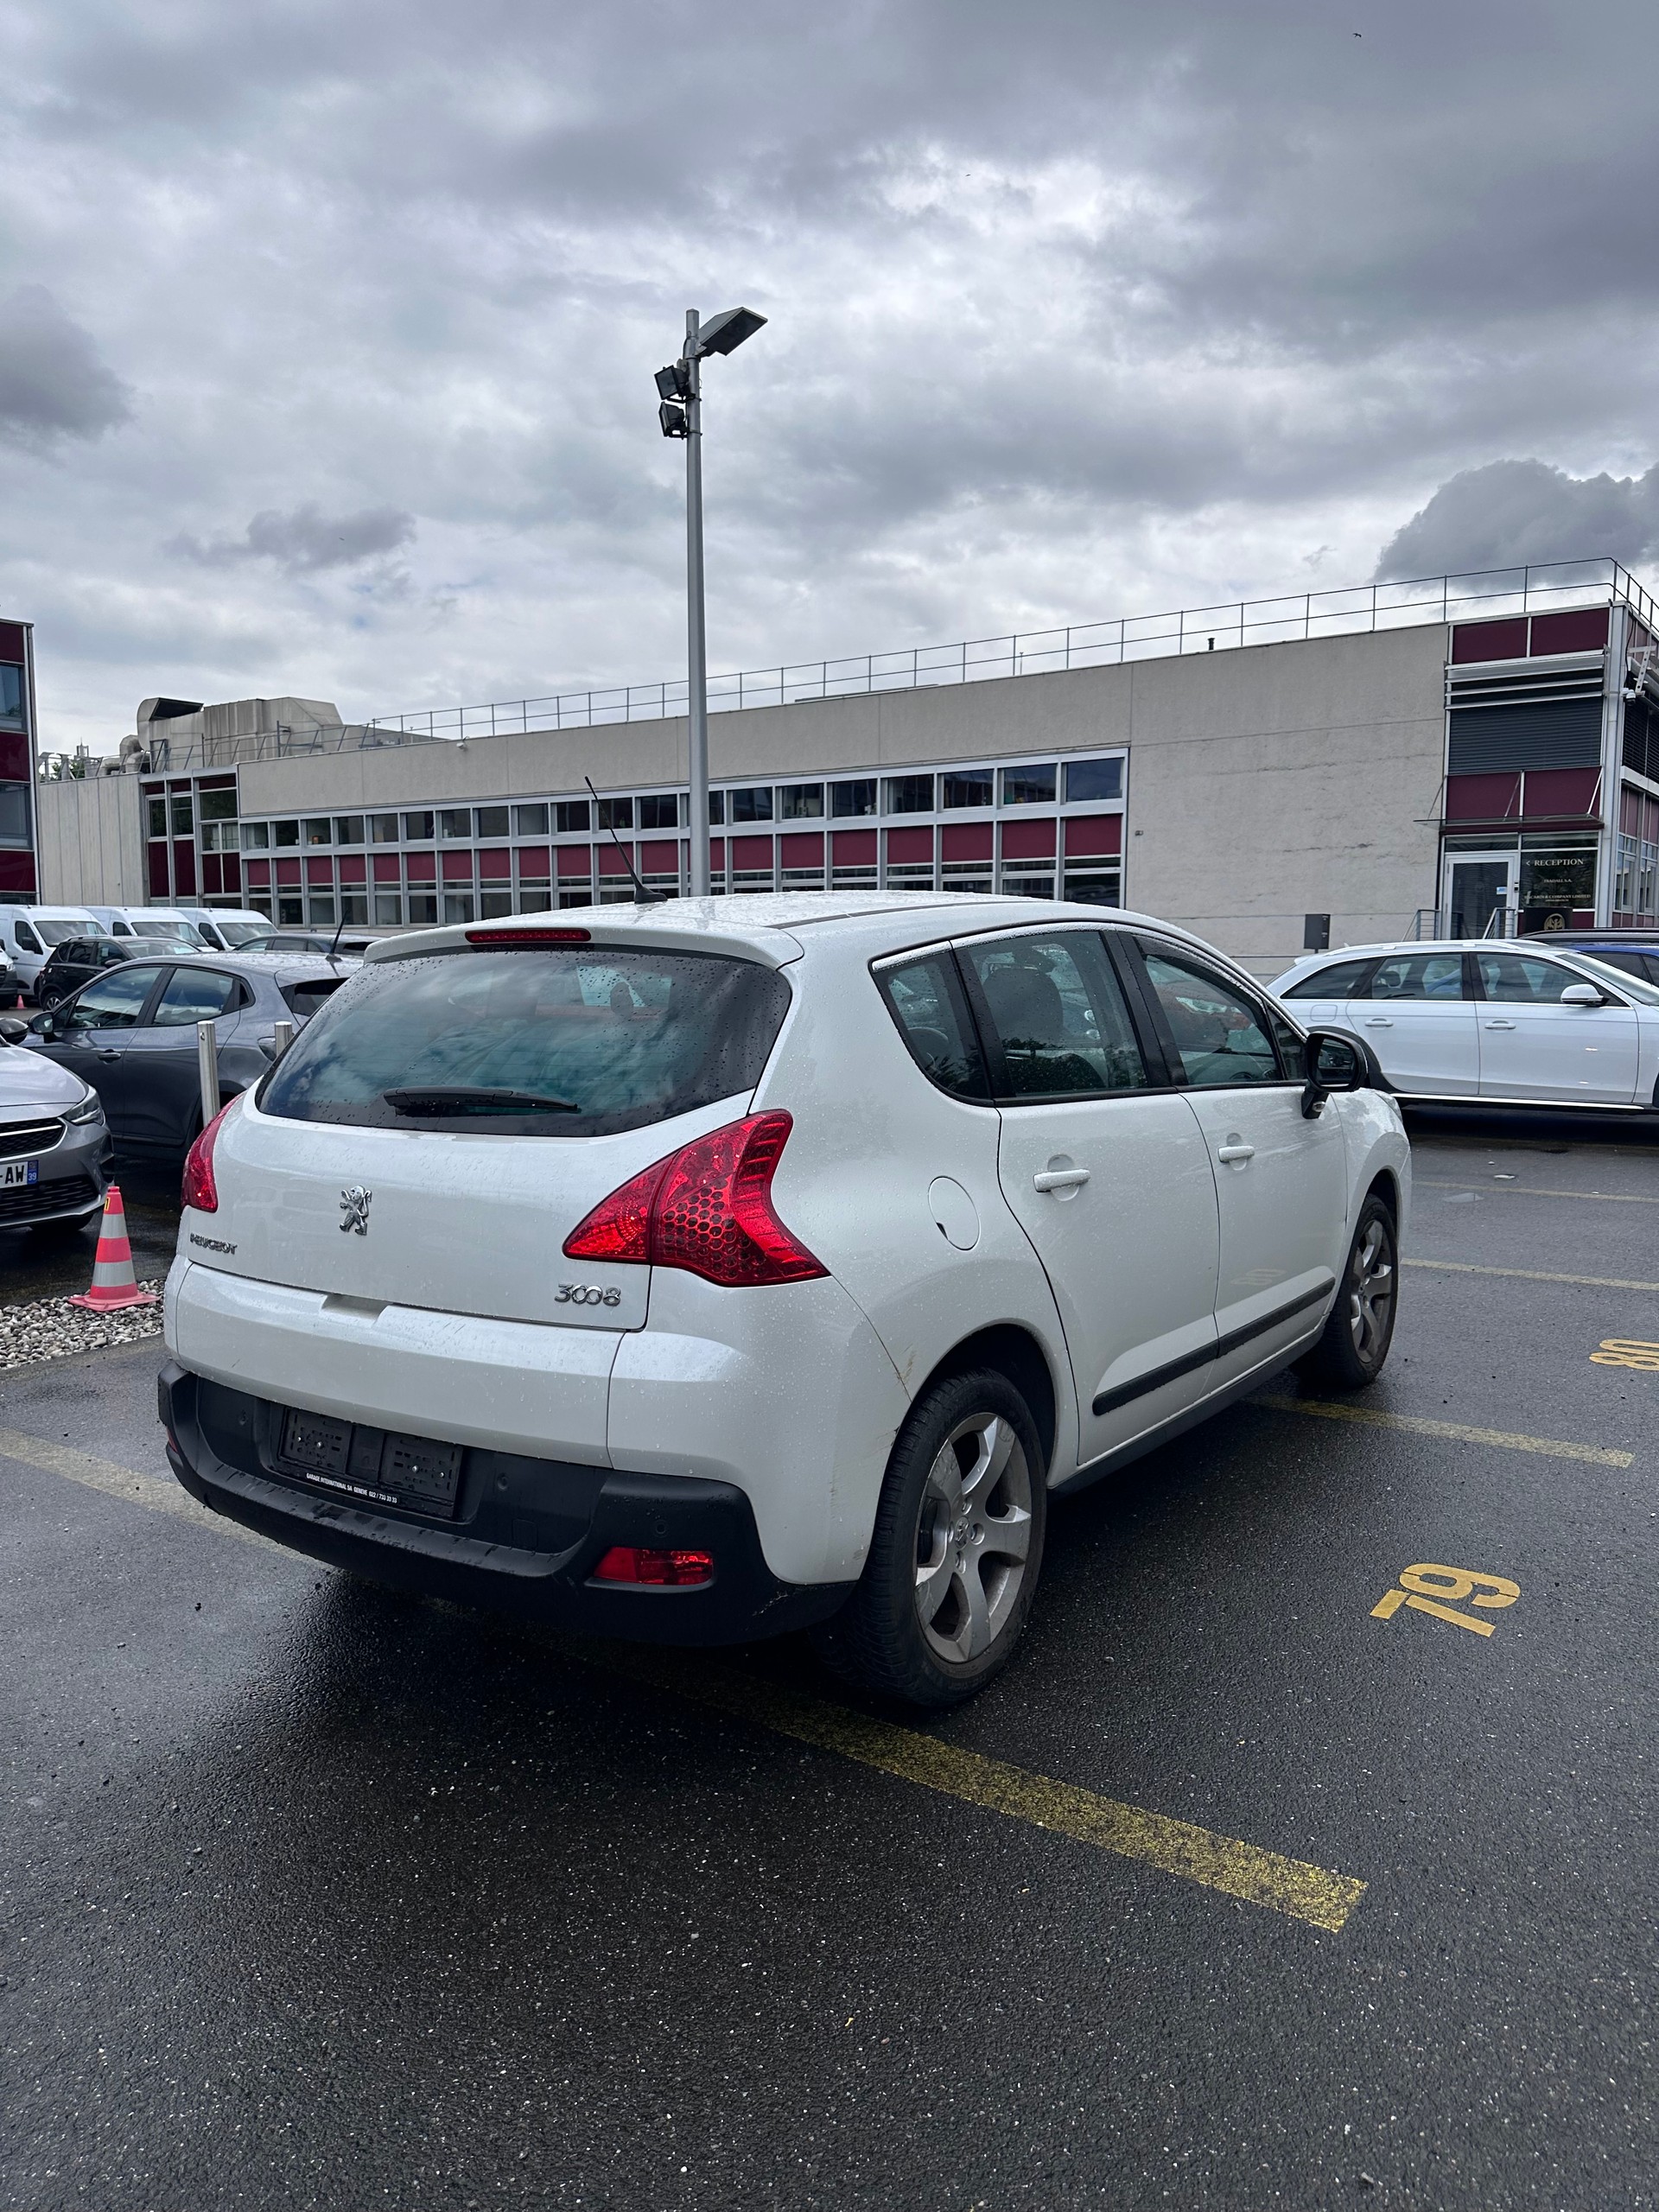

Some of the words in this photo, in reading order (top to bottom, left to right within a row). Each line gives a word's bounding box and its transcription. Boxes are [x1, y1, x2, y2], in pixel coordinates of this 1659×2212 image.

[1534, 858, 1584, 867] RECEPTION
[28, 1172, 37, 1181] 39
[189, 1232, 238, 1255] PEUGEOT
[554, 1283, 621, 1306] 3008
[1589, 1338, 1659, 1371] 80
[306, 1472, 321, 1482] GARAGE
[320, 1477, 347, 1491] INTERNATIONAL
[1370, 1563, 1521, 1637] 79
